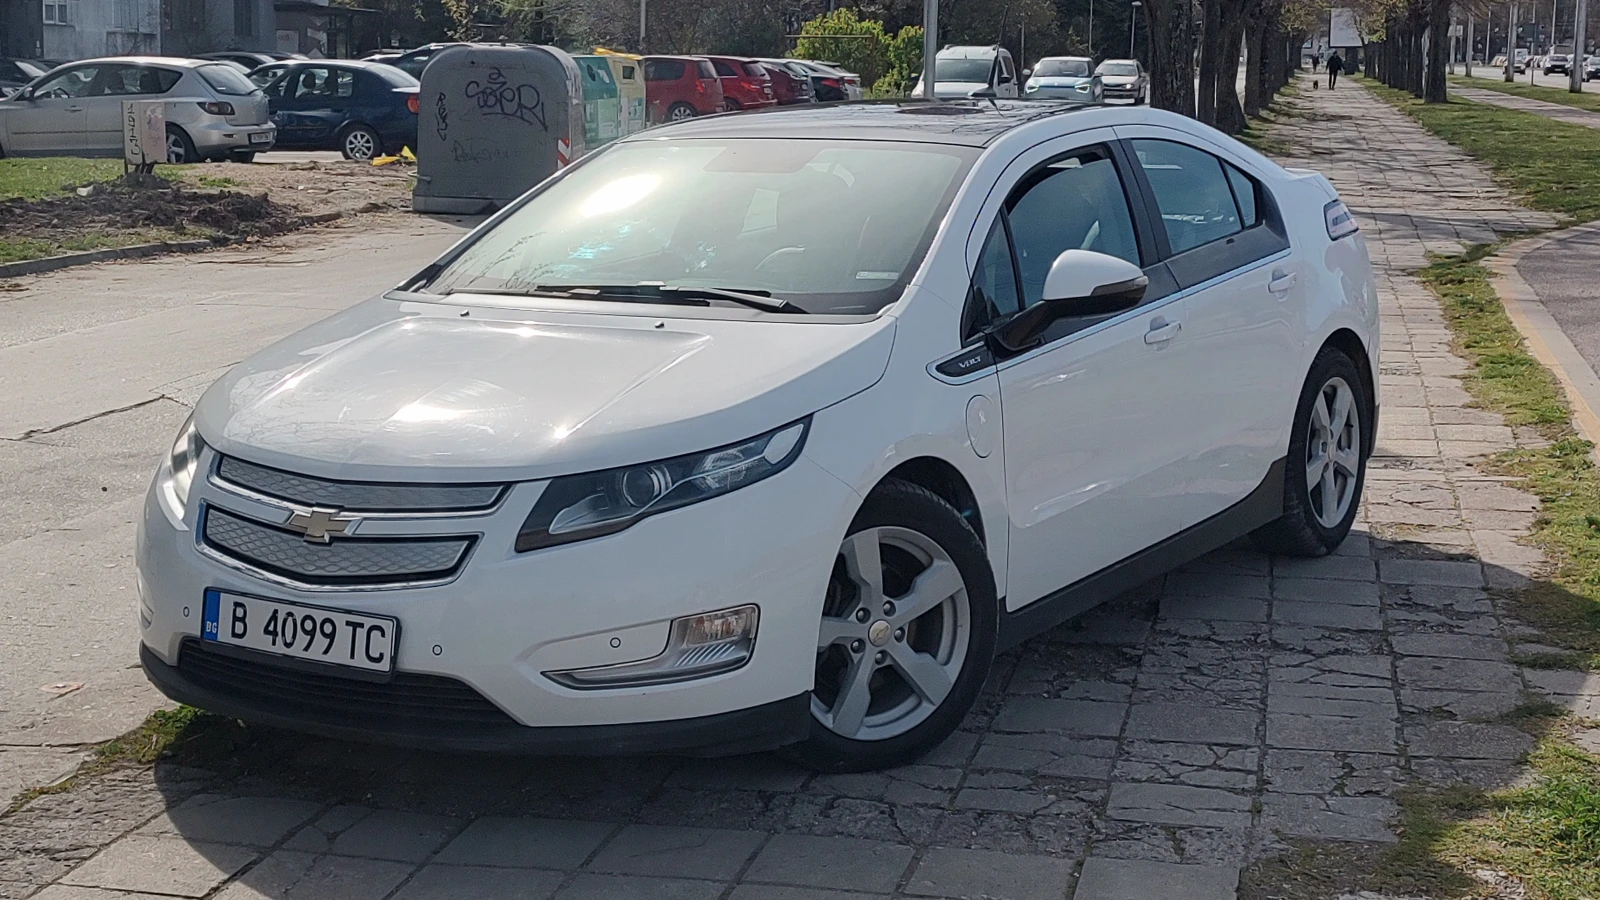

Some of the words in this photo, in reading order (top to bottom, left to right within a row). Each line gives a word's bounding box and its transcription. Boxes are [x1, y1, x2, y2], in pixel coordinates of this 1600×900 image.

[958, 355, 982, 368] VOLT
[205, 620, 218, 634] BG
[231, 601, 248, 639] B
[263, 608, 337, 655] 4099
[345, 620, 386, 664] TC
